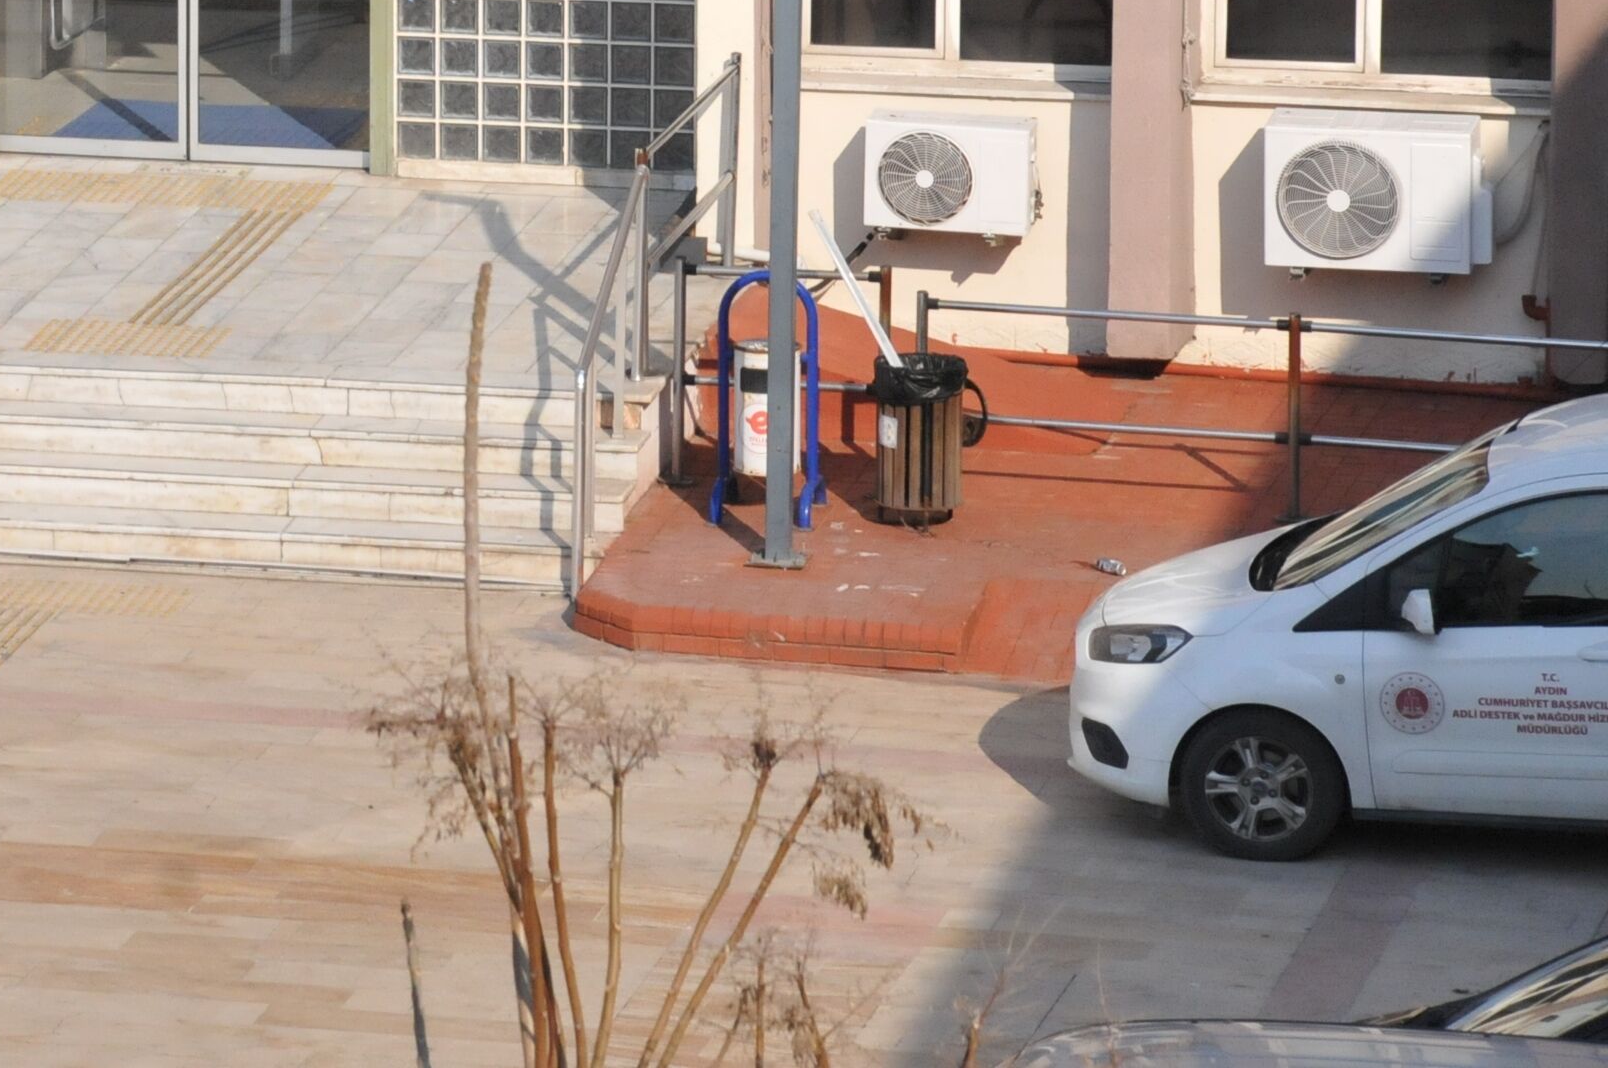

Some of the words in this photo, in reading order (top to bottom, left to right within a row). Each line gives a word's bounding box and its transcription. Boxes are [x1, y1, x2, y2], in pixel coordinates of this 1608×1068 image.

[1541, 673, 1560, 682] T.C.
[1534, 686, 1568, 696] AYDIN
[1478, 697, 1549, 708] CUMHURİYET
[1452, 709, 1478, 719] ADLİ
[1479, 710, 1520, 721] DESTEK
[1522, 713, 1535, 721] ve
[1537, 711, 1586, 723] MAĞDUR
[1516, 724, 1588, 736] MÜDÜRLÜĞÜ
